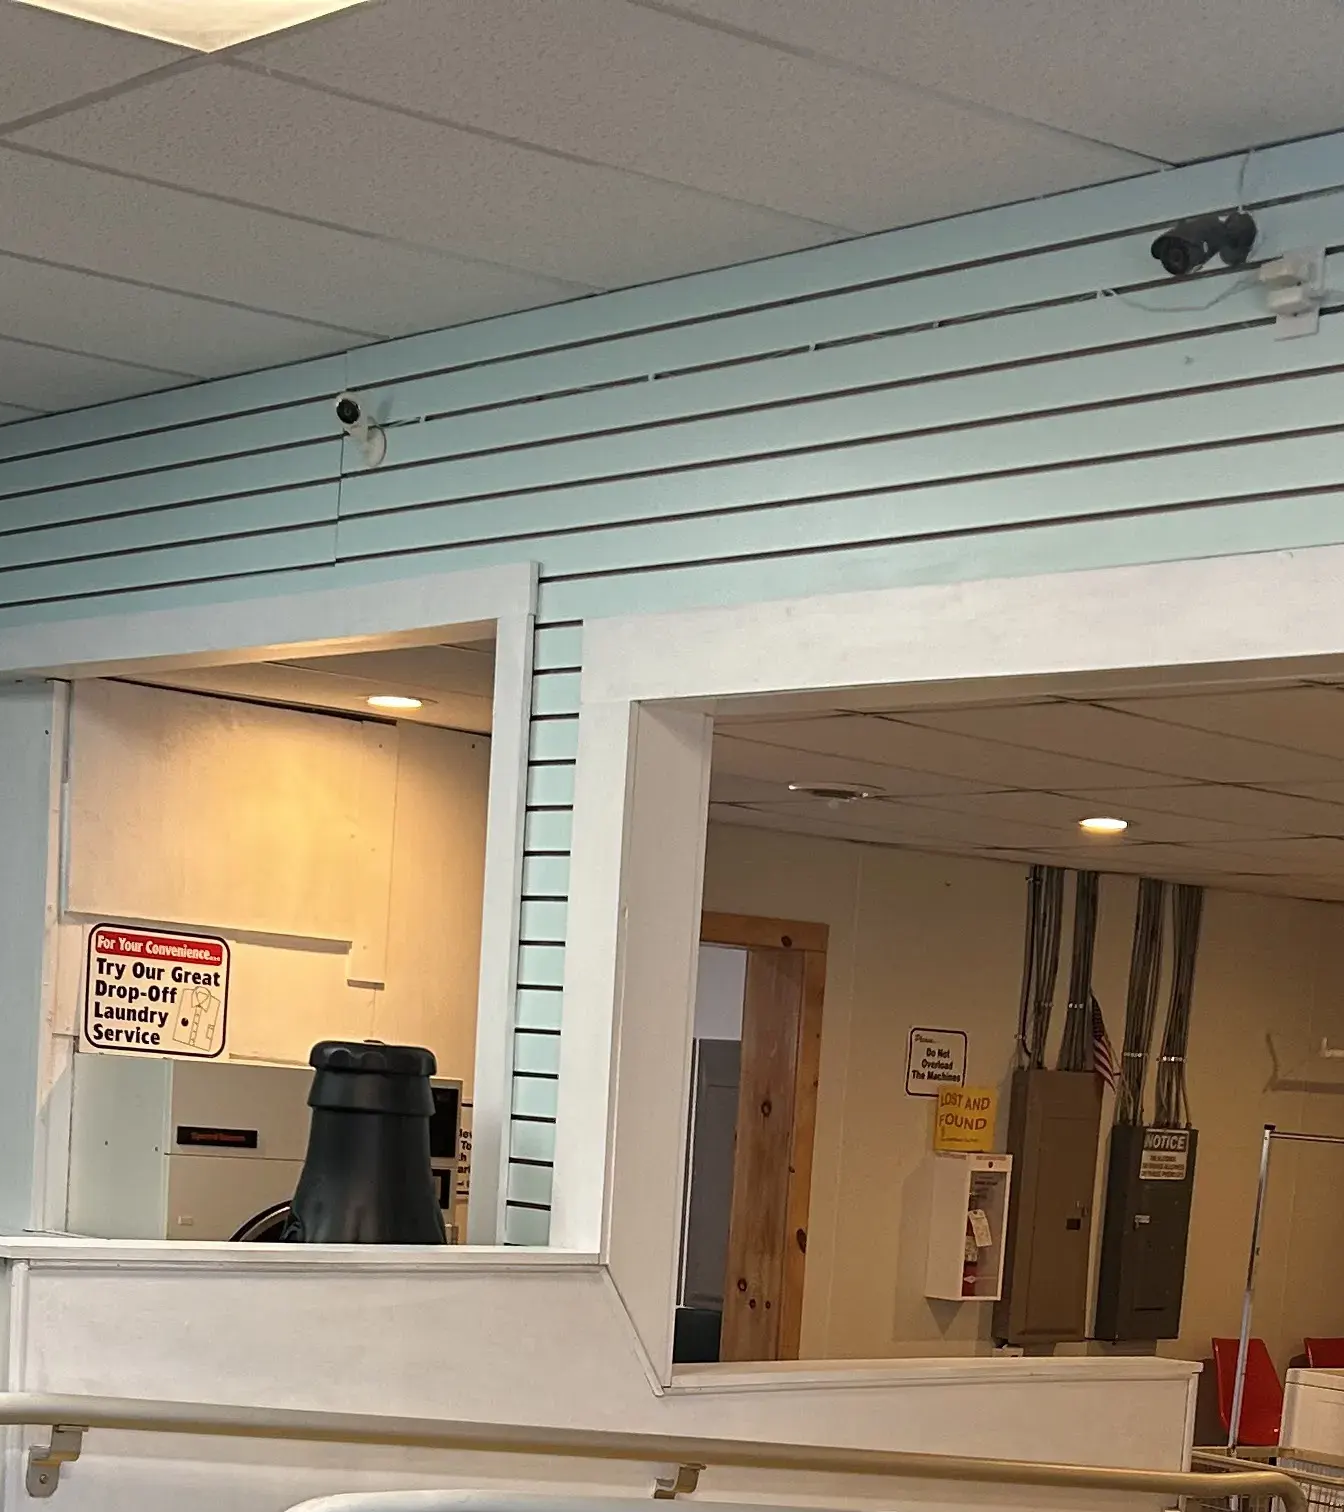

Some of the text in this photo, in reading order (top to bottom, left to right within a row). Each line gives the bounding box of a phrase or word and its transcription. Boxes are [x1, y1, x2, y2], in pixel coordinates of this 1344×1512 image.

[97, 935, 116, 949] For
[119, 937, 143, 953] Your
[96, 957, 221, 987] Try Our Great
[95, 979, 177, 1003] Drop-Off
[94, 1001, 169, 1028] Laundry
[93, 1023, 160, 1045] Service
[927, 1048, 950, 1058] Do Not
[921, 1058, 953, 1070] Overload
[912, 1069, 960, 1082] The Machines
[940, 1093, 991, 1111] LOST AND
[939, 1112, 987, 1130] FOUND
[1144, 1133, 1186, 1150] NOTICE
